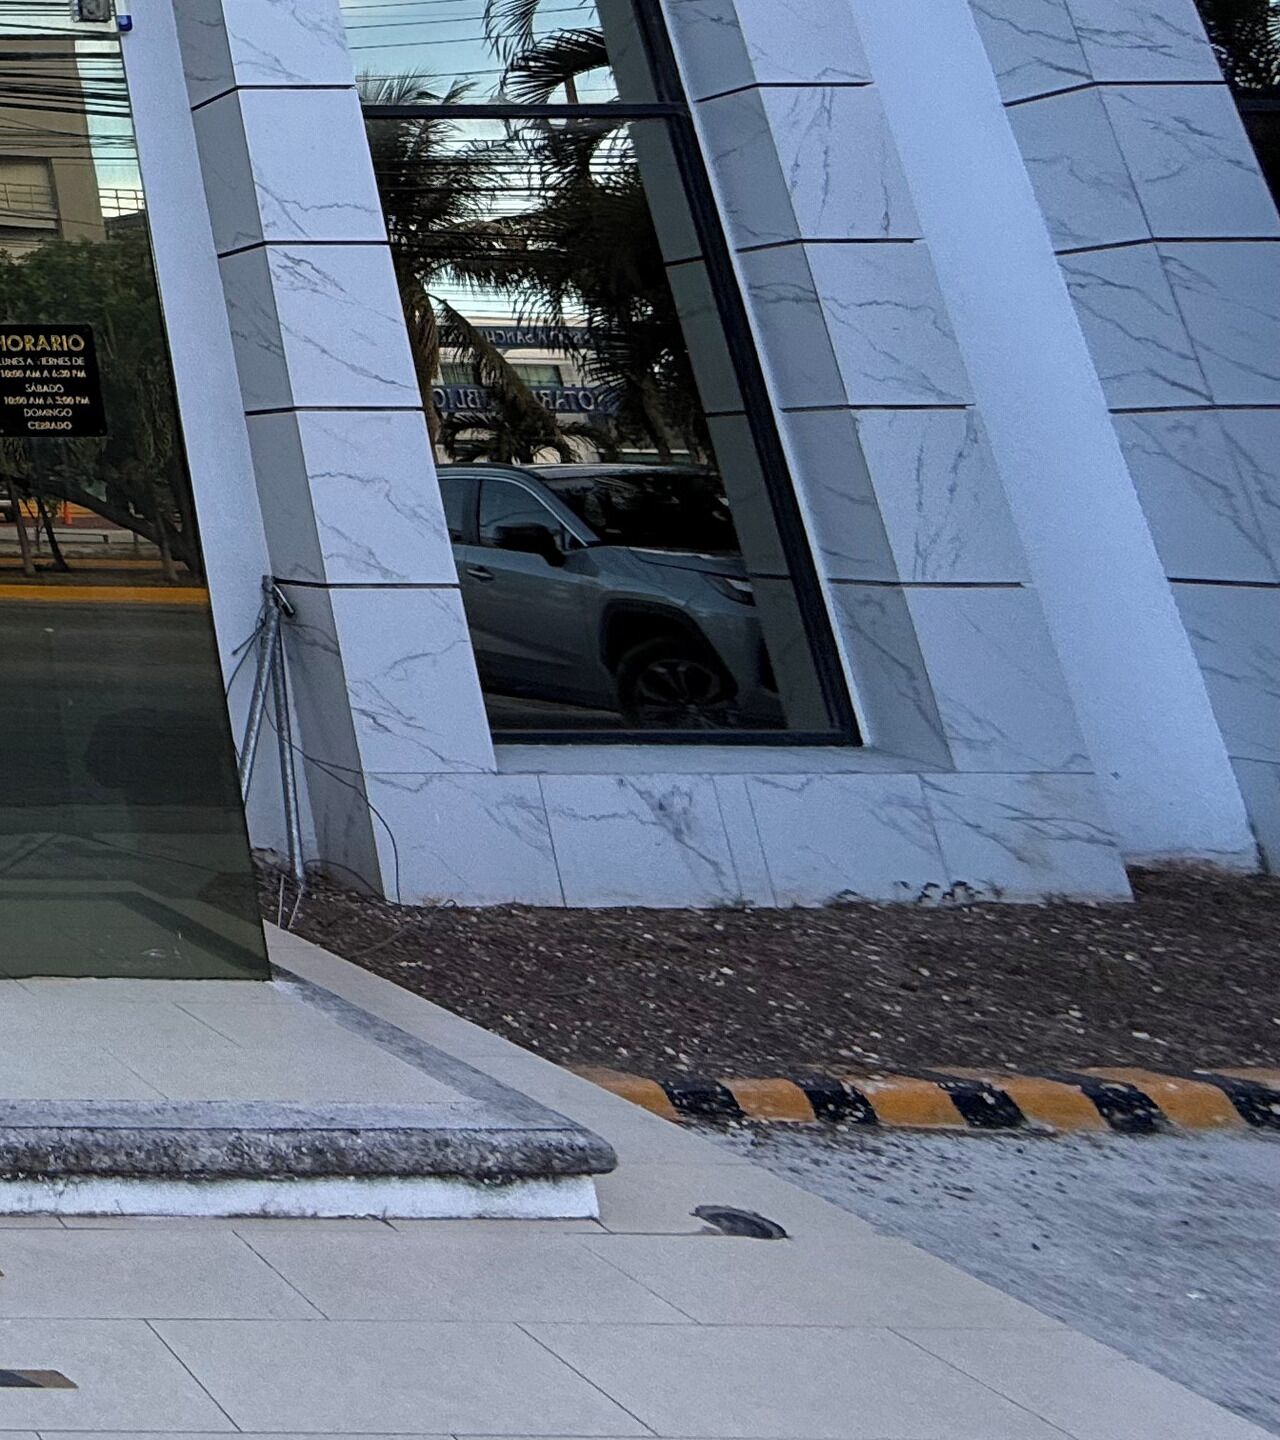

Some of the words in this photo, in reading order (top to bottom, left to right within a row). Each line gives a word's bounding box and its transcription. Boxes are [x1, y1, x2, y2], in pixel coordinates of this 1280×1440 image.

[72, 357, 85, 366] DE
[25, 382, 64, 393] SÁBADO
[24, 408, 72, 417] DOMINGO
[27, 421, 72, 430] CERRADO
